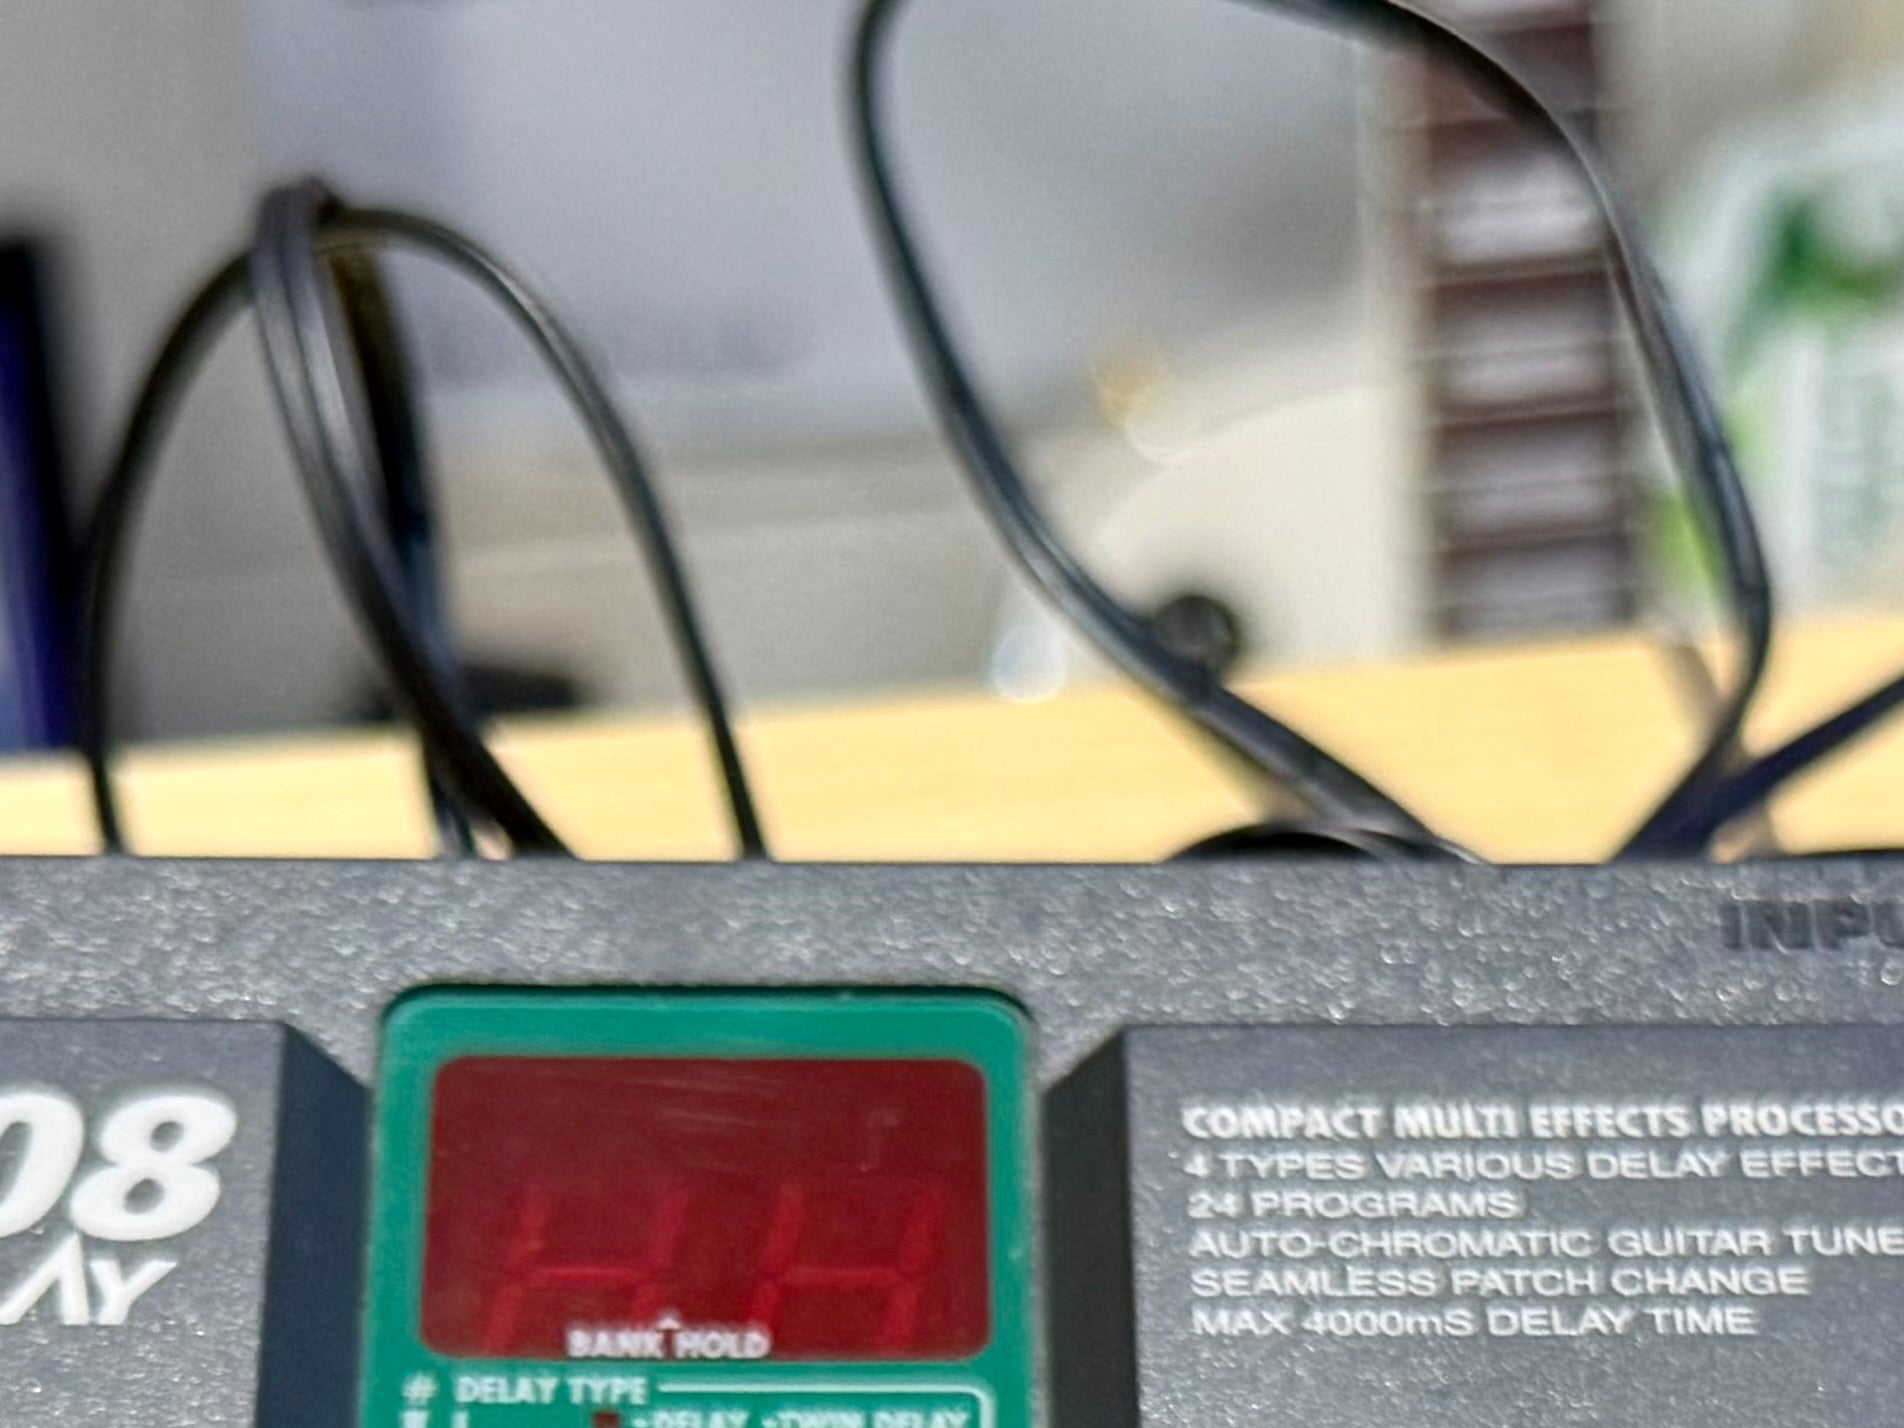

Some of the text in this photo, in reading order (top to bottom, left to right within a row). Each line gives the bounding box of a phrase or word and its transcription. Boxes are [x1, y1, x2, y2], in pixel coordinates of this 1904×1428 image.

[1181, 1103, 1384, 1140] COMPACT
[1394, 1102, 1519, 1139] MULTI
[1530, 1102, 1693, 1138] EFFECTS
[1183, 1153, 1209, 1179] 4
[1218, 1152, 1365, 1180] TYPES
[1376, 1151, 1575, 1180] VARIOUS
[1587, 1150, 1729, 1179] DELAY
[1188, 1191, 1523, 1218] 24 PROGRAMS
[1189, 1229, 1593, 1258] AUTO-CHROMATIC
[1608, 1227, 1773, 1257] GUITAR
[1190, 1265, 1811, 1297] SEAMLESS PATCH CHANGE
[1192, 1305, 1759, 1337] MAX 4000mS DELAY TIME
[566, 1329, 773, 1359] BANK HOLD
[456, 1376, 648, 1404] DELAY TYPE
